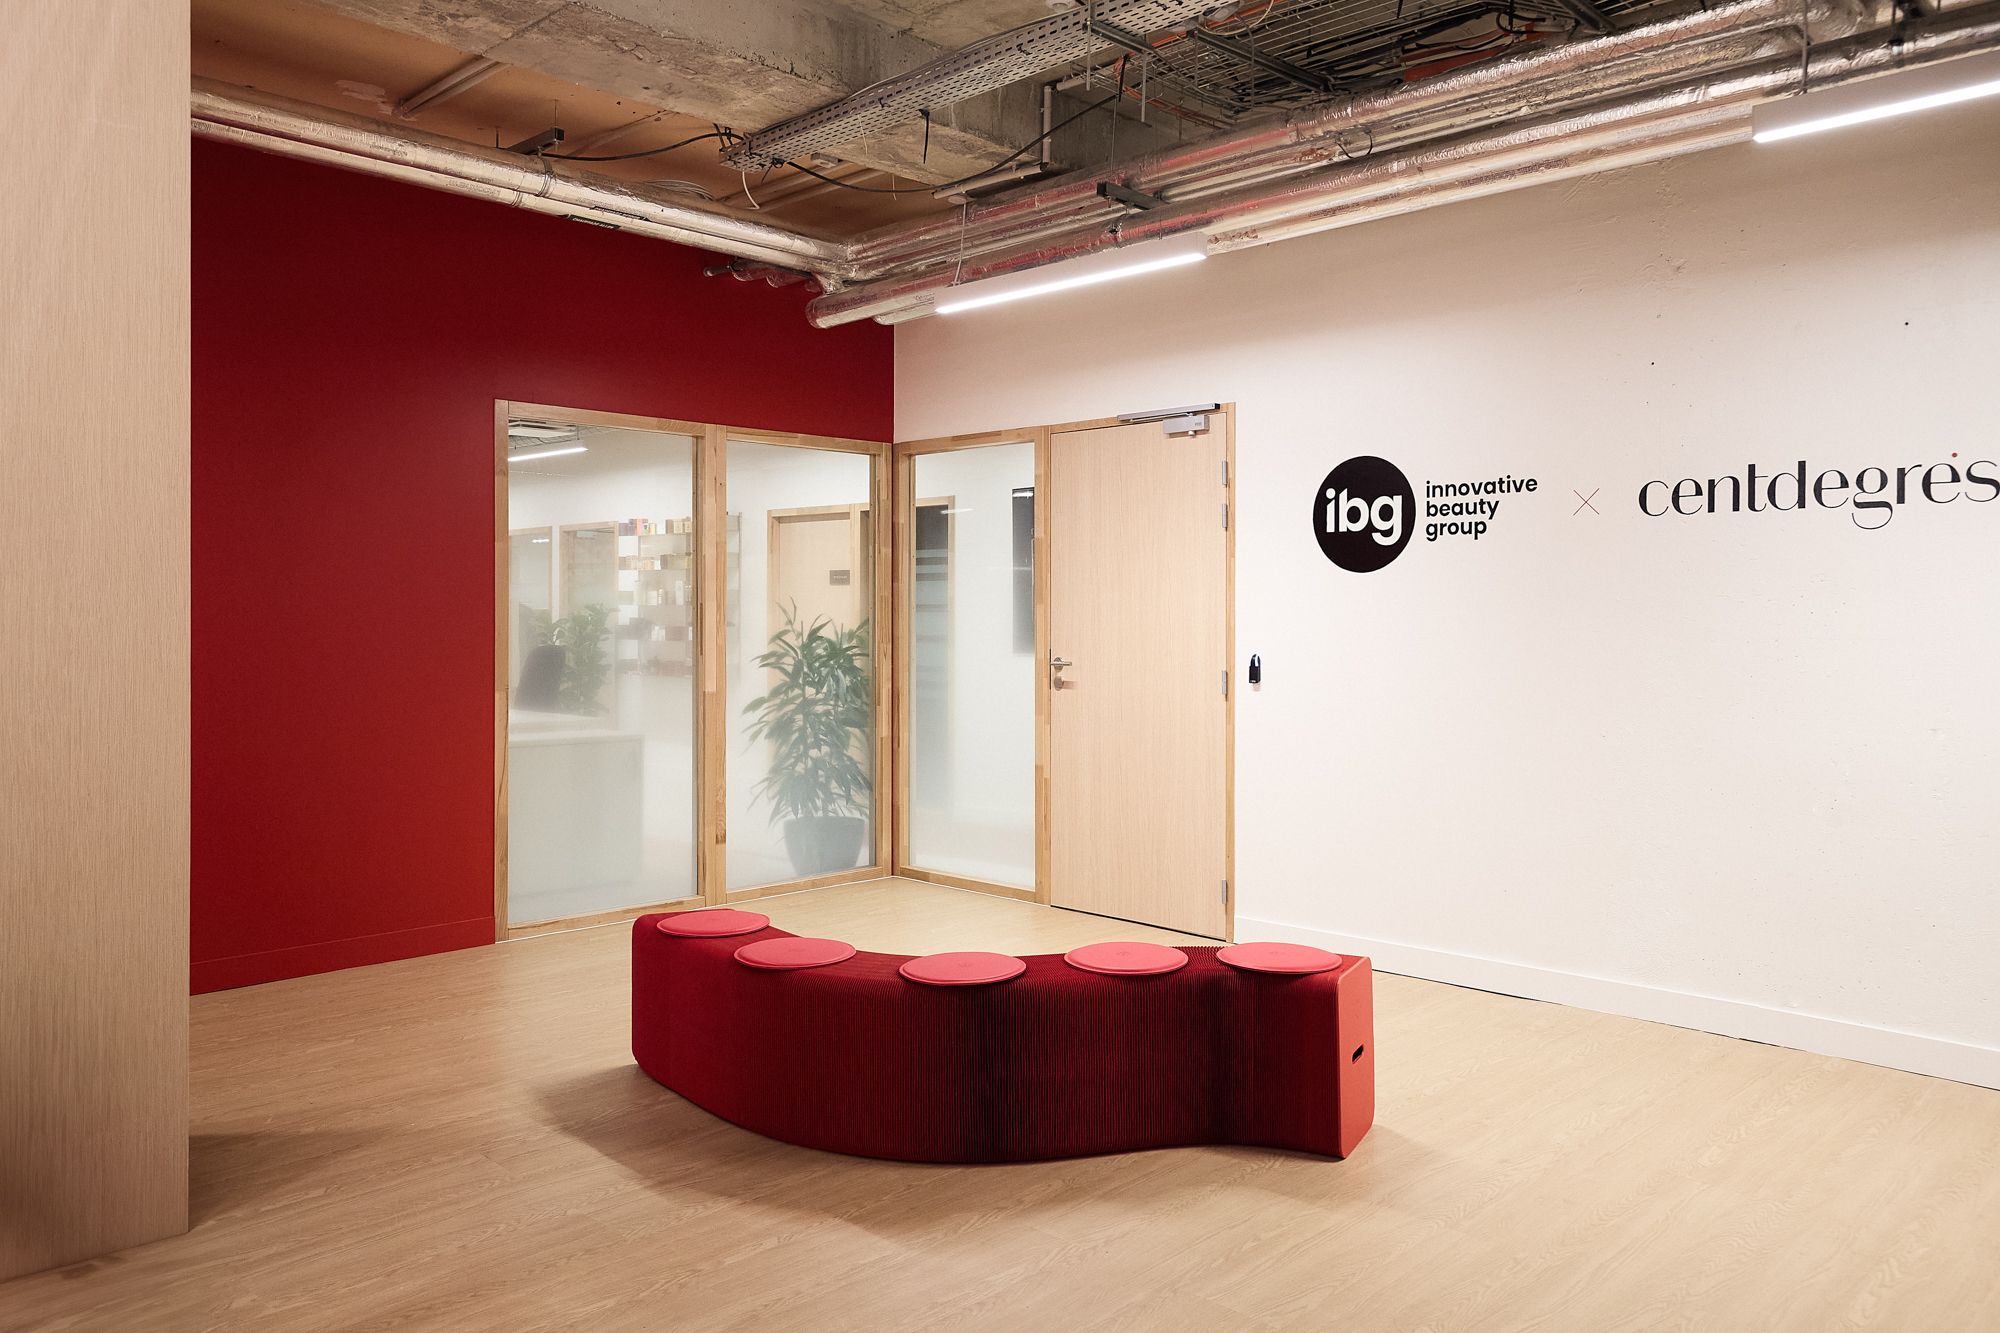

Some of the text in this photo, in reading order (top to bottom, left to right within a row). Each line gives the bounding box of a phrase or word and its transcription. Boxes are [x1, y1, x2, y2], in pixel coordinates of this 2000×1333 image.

[1426, 475, 1538, 498] innovative
[1326, 488, 1403, 546] ibg
[1426, 498, 1500, 520] beauty
[1426, 520, 1487, 542] group
